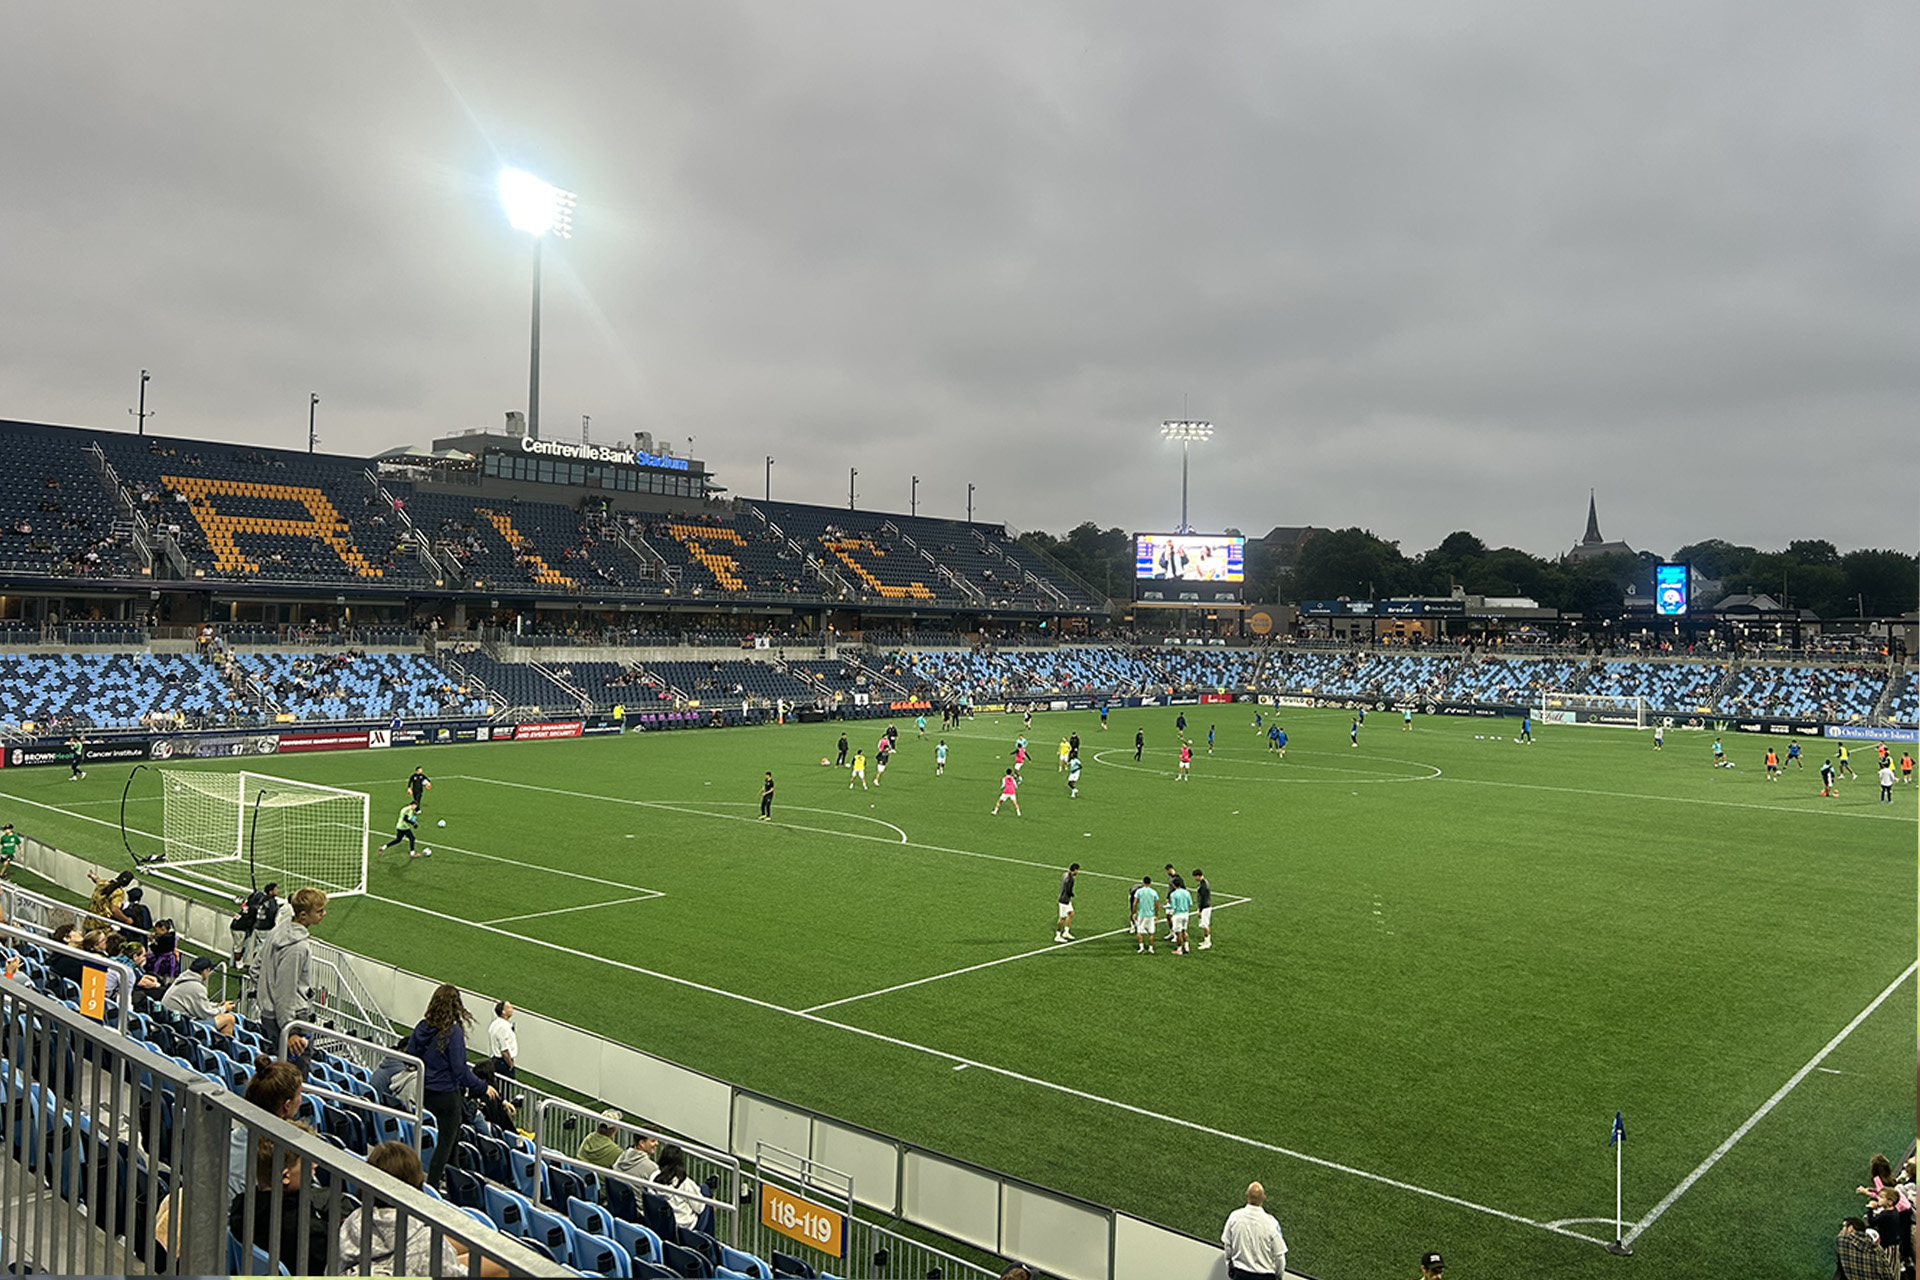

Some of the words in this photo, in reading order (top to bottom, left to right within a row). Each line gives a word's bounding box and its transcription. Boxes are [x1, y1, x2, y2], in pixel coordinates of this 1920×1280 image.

[521, 436, 600, 460] Centreville
[599, 447, 635, 465] Bank
[636, 451, 689, 471] Stadium
[493, 726, 515, 734] BEST
[519, 725, 541, 733] CROWD
[541, 723, 580, 731] MANAGEMENT
[1842, 728, 1865, 736] Ortho
[1865, 729, 1888, 738] Rhode
[1890, 731, 1914, 739] Island
[113, 749, 143, 758] Institute
[232, 744, 244, 755] 37
[24, 753, 55, 761] BROWN
[55, 752, 75, 760] Healt
[88, 976, 97, 1010] 119
[769, 1197, 832, 1244] 118-119
